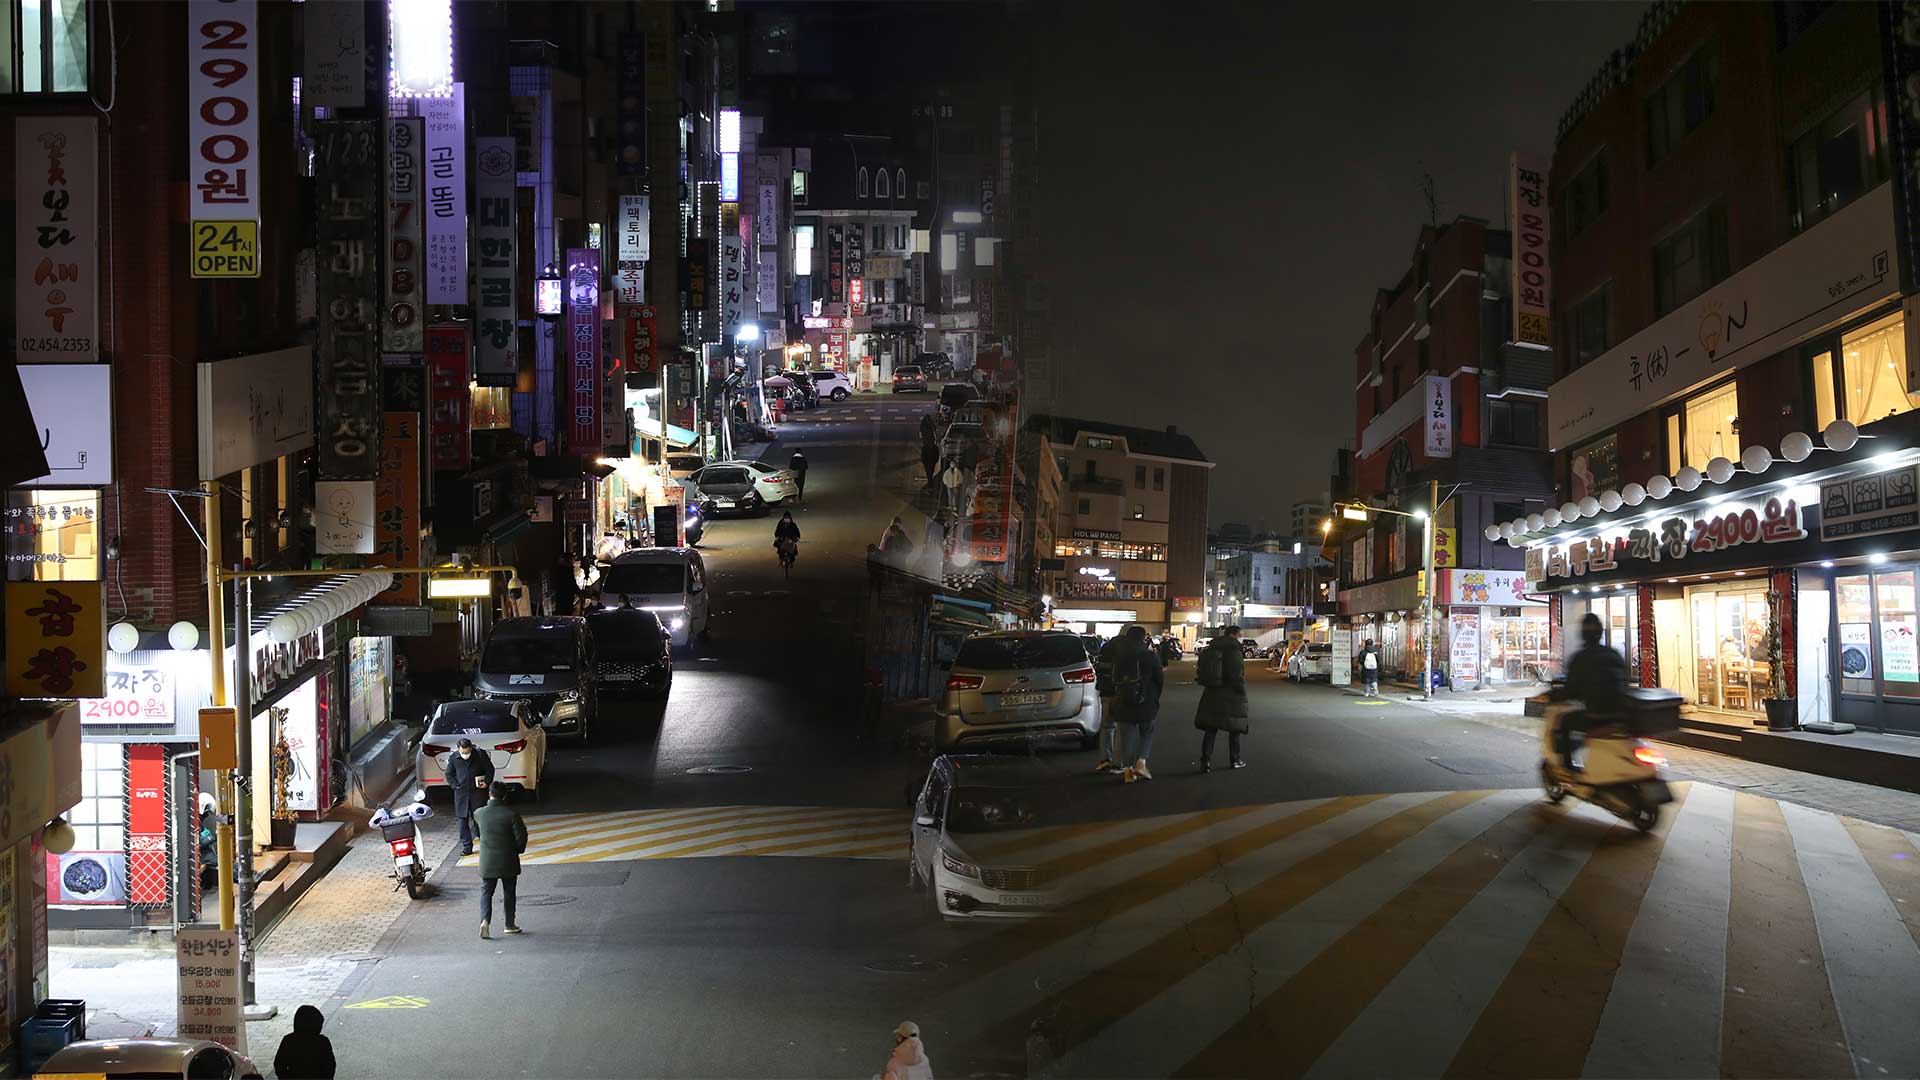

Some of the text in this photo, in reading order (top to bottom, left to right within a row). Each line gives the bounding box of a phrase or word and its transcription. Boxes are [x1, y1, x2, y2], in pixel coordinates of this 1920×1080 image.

[197, 19, 249, 204] 2900원
[198, 255, 252, 272] OPEN
[480, 197, 513, 350] 대한곱창
[621, 269, 641, 302] 족발
[1521, 213, 1546, 309] 2900원
[35, 256, 78, 333] 새우
[632, 321, 651, 370] 노래방
[62, 505, 95, 520] 즐기는
[1629, 517, 1690, 561] 짜장
[1692, 498, 1802, 551] 2900원
[23, 587, 89, 694] 곱창
[107, 669, 168, 693] 짜장
[86, 697, 168, 719] 2900원
[180, 938, 235, 958] 착한식당
